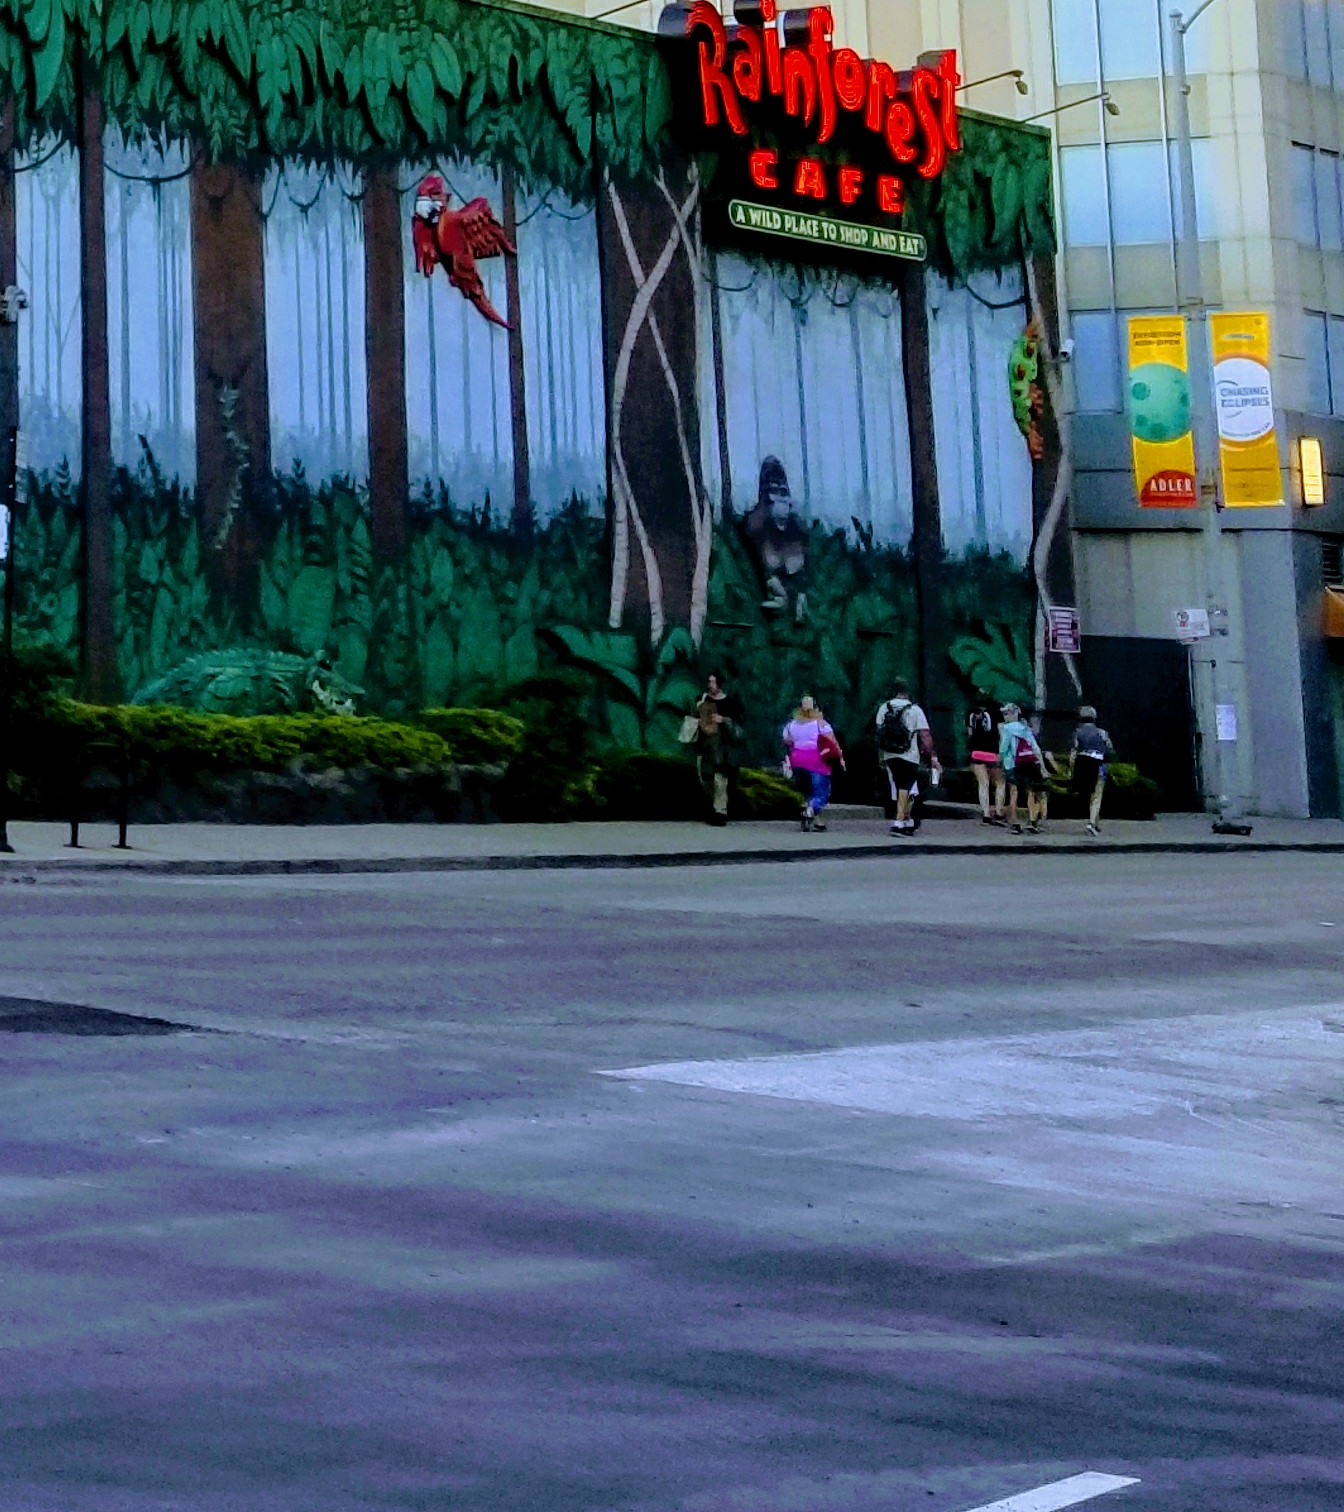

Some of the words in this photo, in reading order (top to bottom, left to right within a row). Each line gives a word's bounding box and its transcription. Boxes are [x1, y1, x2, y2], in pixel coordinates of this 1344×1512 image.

[749, 149, 905, 213] CAFE
[735, 204, 746, 223] A
[749, 207, 781, 230] WILD
[784, 214, 819, 237] PLACE
[822, 221, 837, 241] TO
[839, 224, 869, 246] SHOP
[872, 230, 898, 251] AND
[899, 235, 920, 255] EAT
[1220, 386, 1269, 398] CHASING
[1221, 397, 1270, 408] ECLIPSES
[1149, 477, 1193, 493] ADLER
